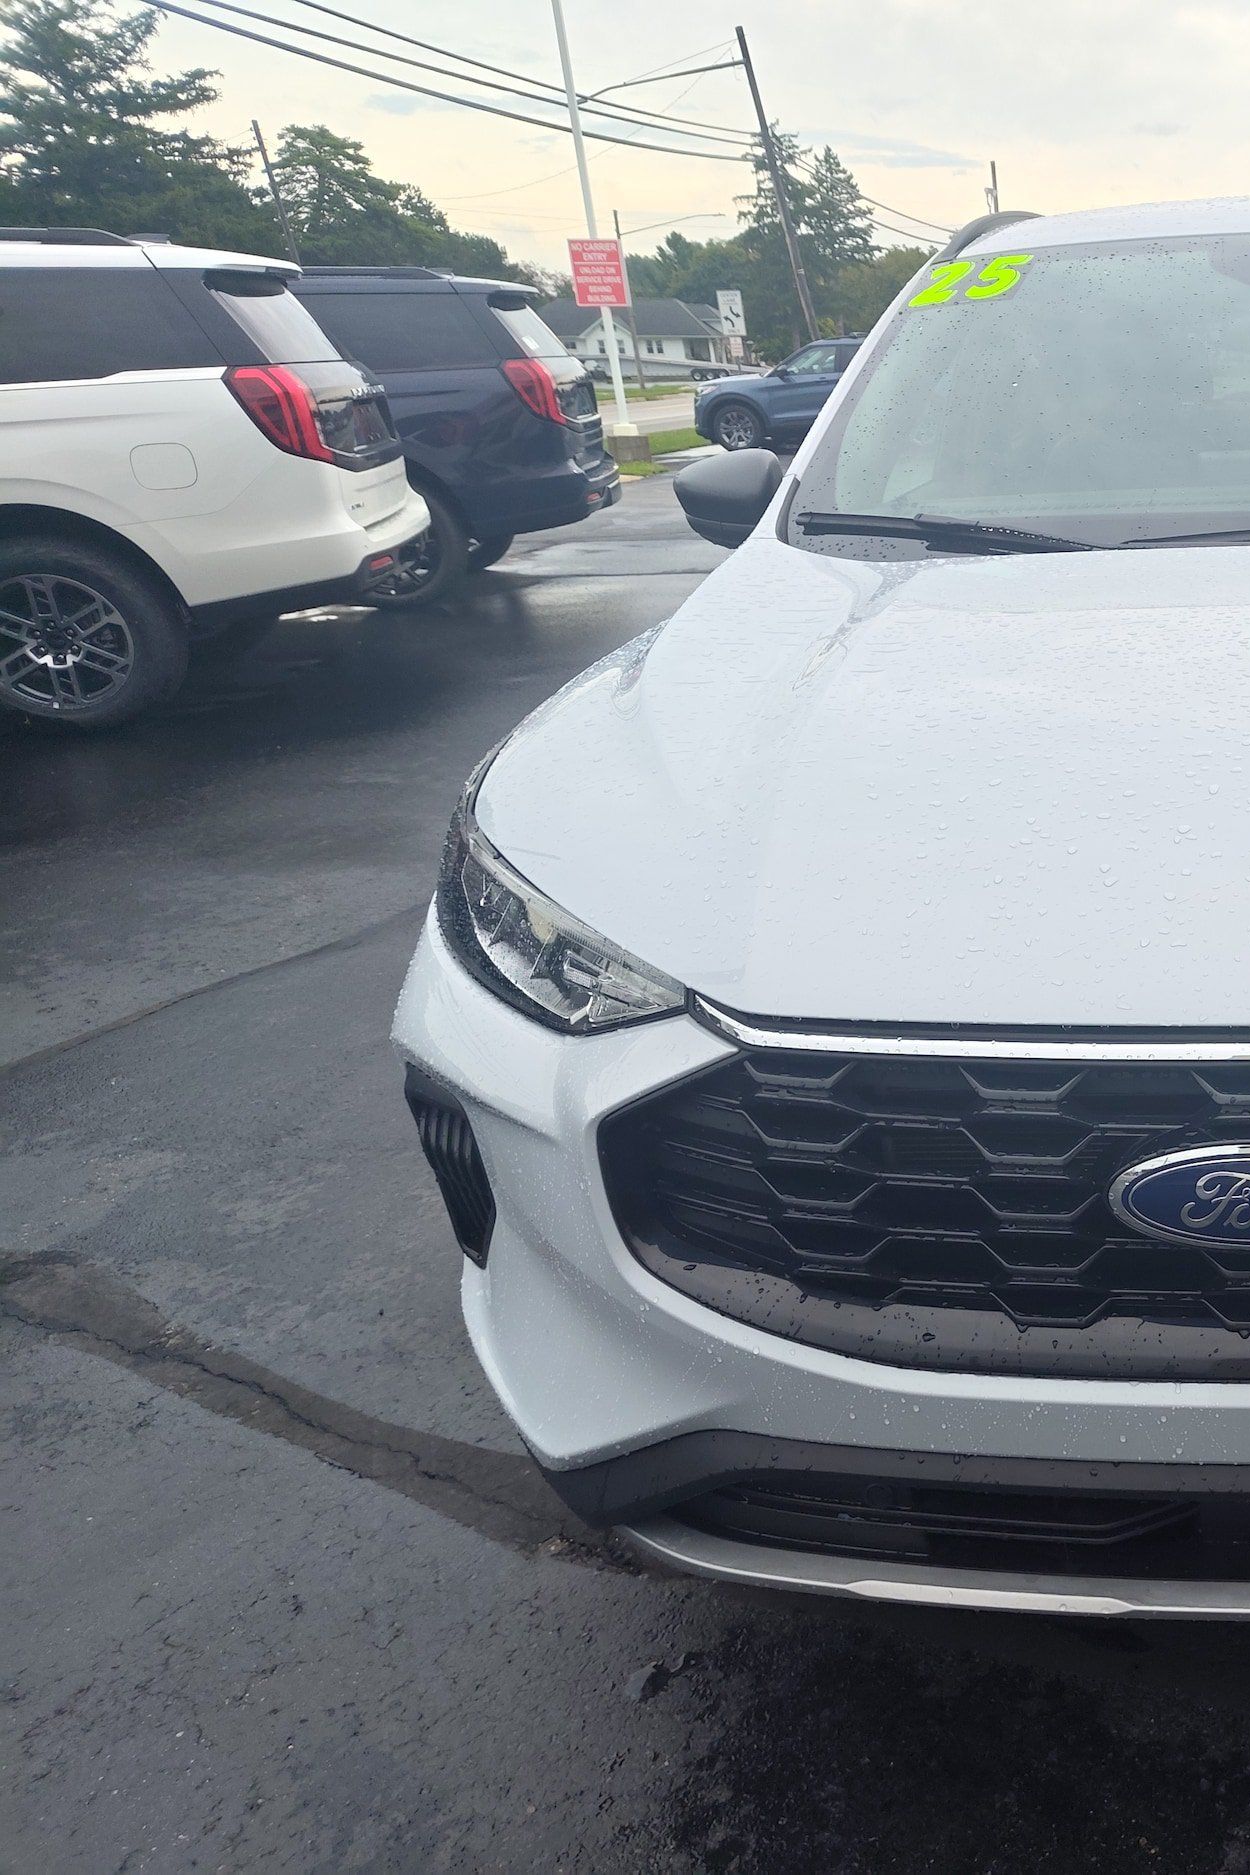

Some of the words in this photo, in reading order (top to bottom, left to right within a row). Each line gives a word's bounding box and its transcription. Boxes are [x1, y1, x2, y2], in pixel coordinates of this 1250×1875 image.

[570, 242, 582, 251] NO
[583, 242, 617, 251] CARRIER
[582, 253, 608, 261] ENTRY
[908, 254, 1034, 307] 25
